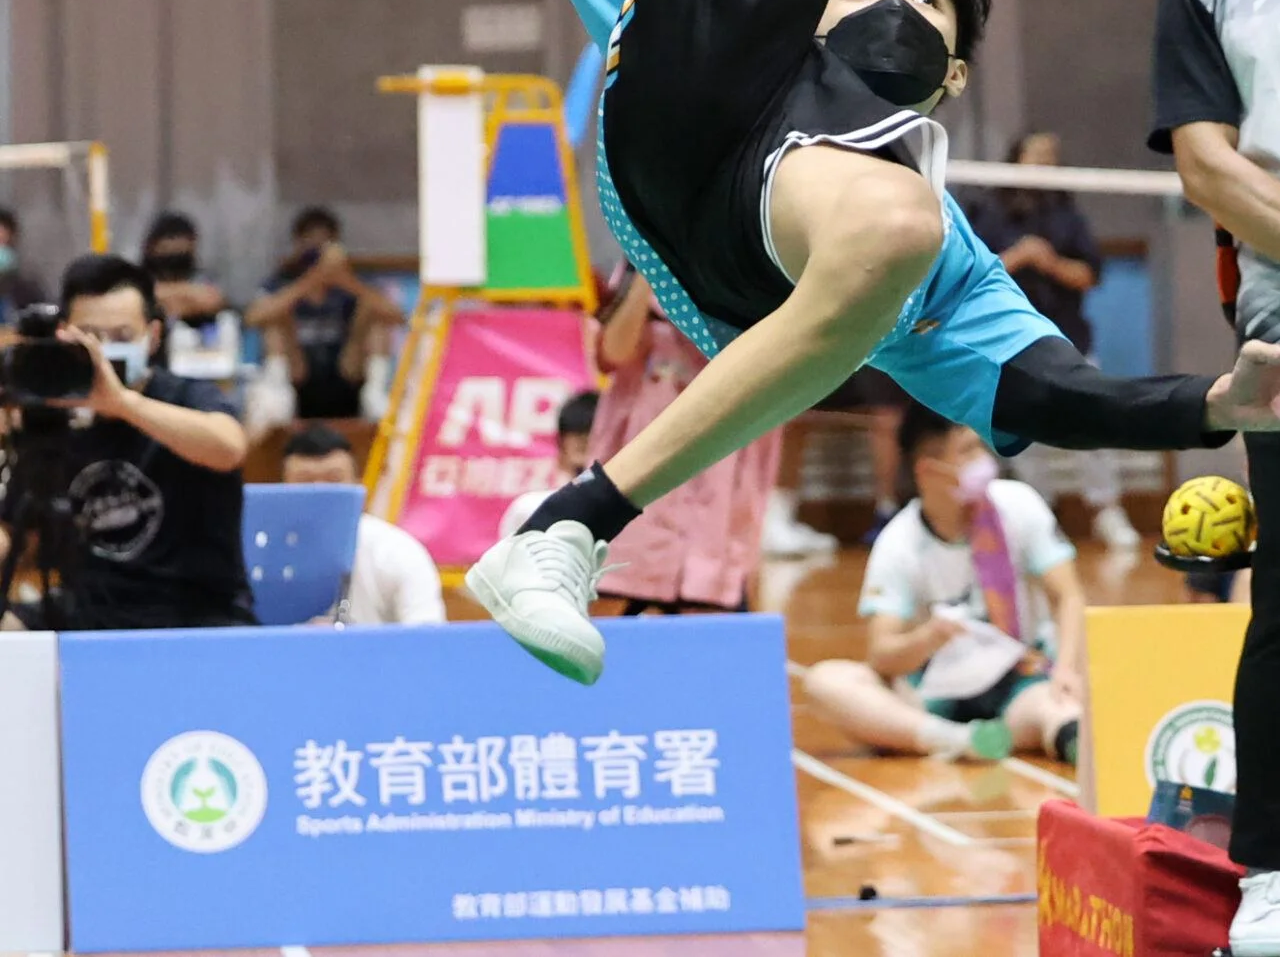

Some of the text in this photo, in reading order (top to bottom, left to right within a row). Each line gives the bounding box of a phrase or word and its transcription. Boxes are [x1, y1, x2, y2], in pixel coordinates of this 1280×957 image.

[294, 729, 720, 809] 教育部體育署
[296, 804, 725, 837] Sports Administration Ministry of Education
